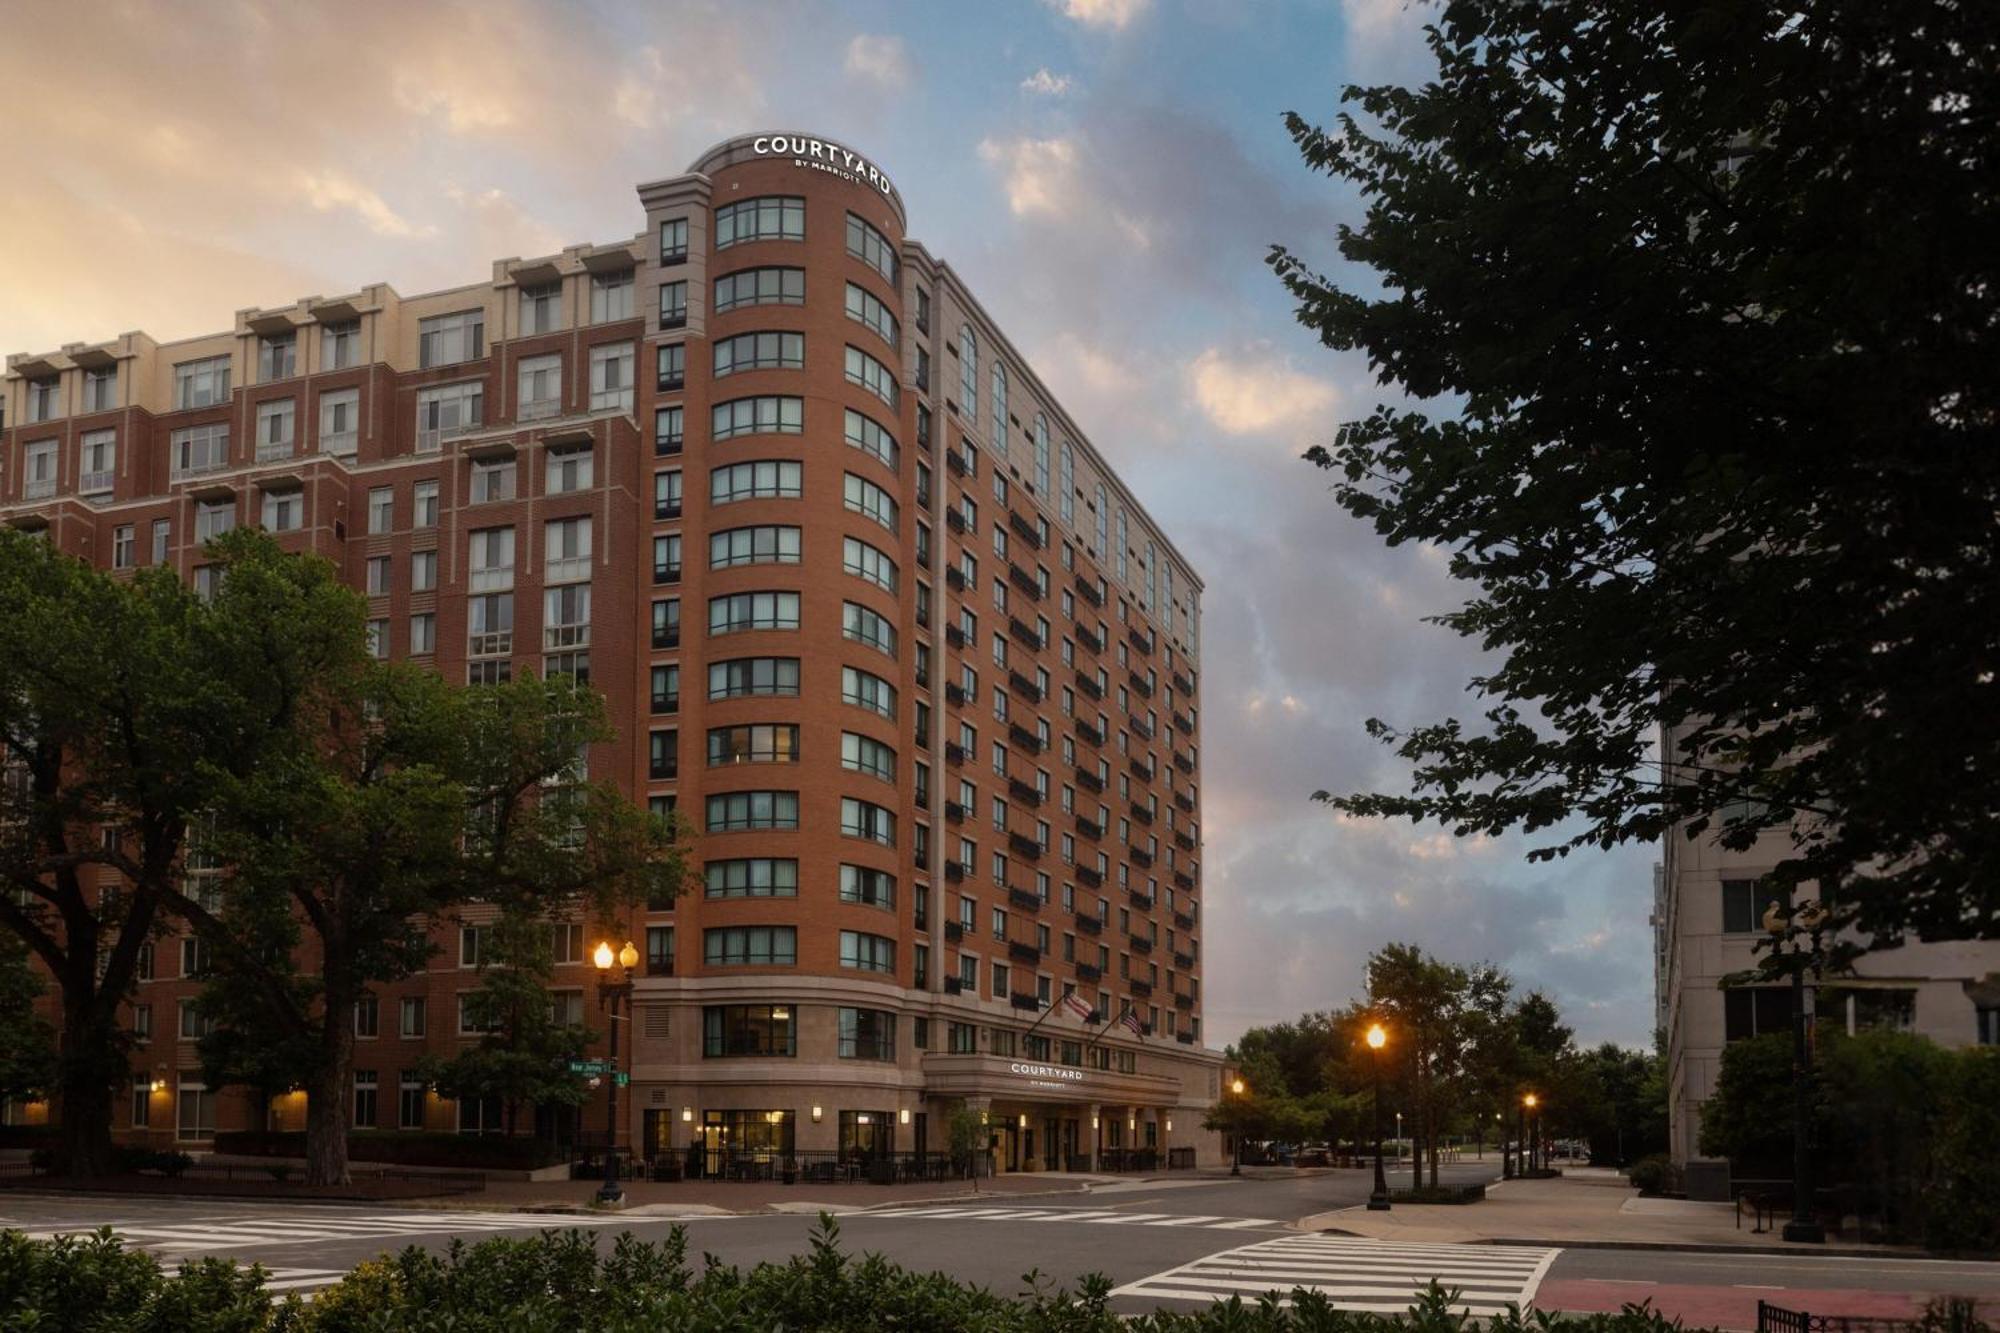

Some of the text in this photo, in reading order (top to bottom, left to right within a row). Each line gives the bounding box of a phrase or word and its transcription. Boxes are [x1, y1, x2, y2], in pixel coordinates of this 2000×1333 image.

[754, 136, 890, 194] COURTYARD
[795, 159, 860, 184] BY MARRIOTT
[1011, 1063, 1082, 1080] COURTYARD
